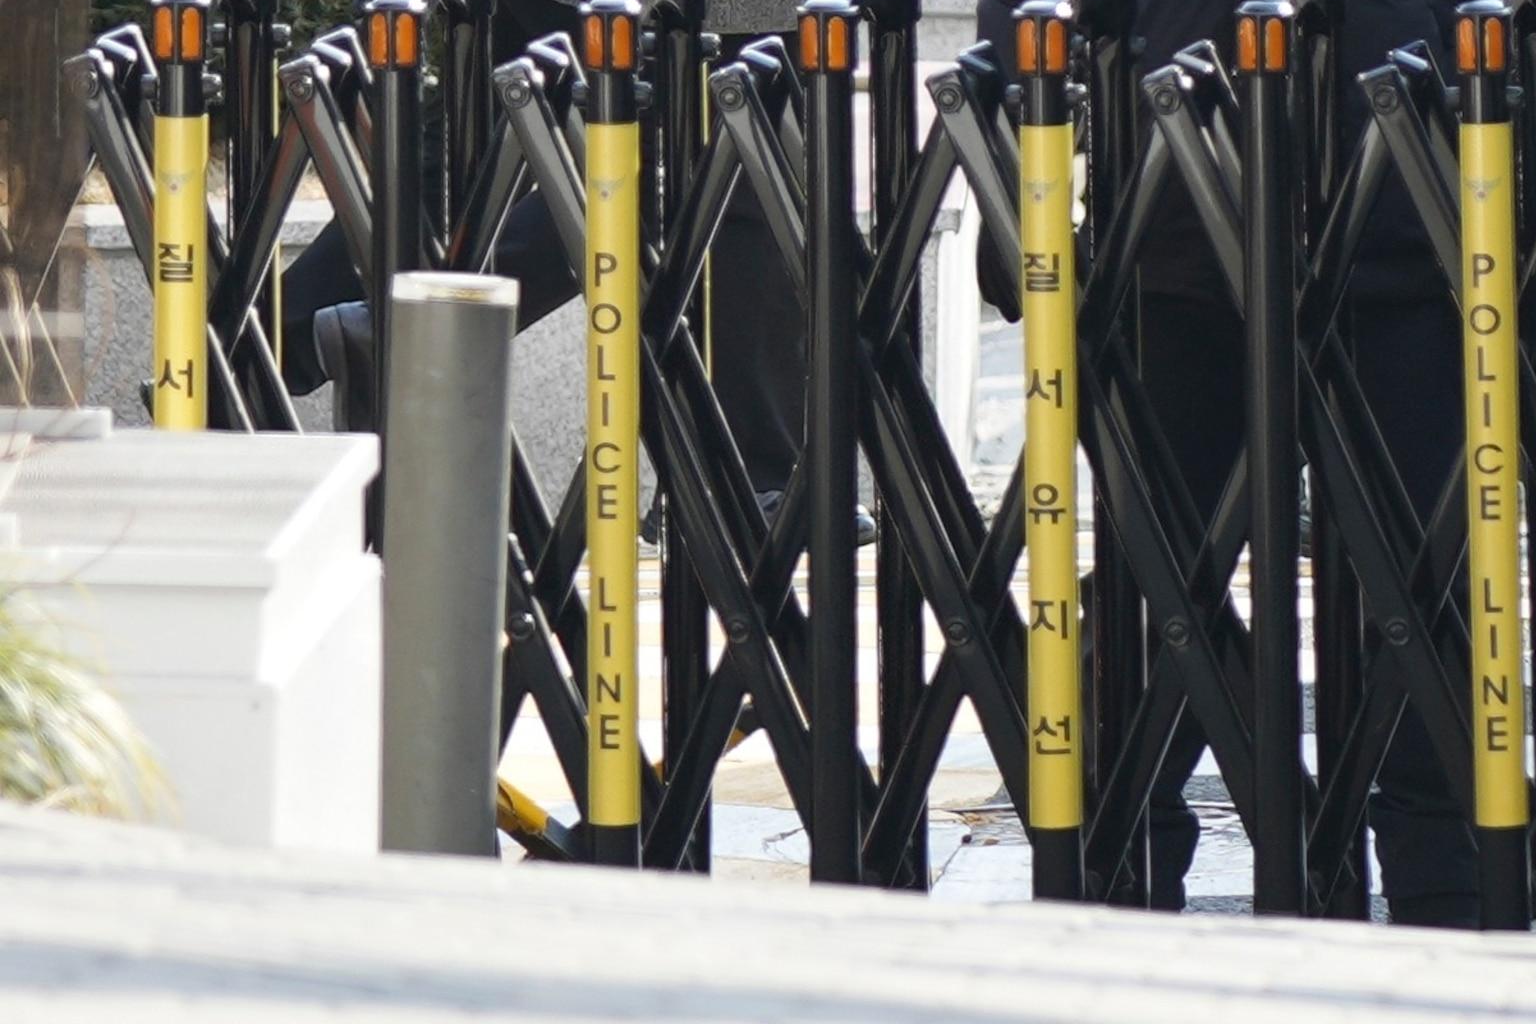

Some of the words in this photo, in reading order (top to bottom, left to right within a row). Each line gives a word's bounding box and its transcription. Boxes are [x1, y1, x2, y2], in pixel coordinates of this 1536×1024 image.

[591, 252, 622, 520] POLICE
[1023, 252, 1071, 755] 질서유지선
[1469, 253, 1504, 521] POLICE
[596, 576, 621, 750] LINE
[1482, 577, 1509, 752] LINE
